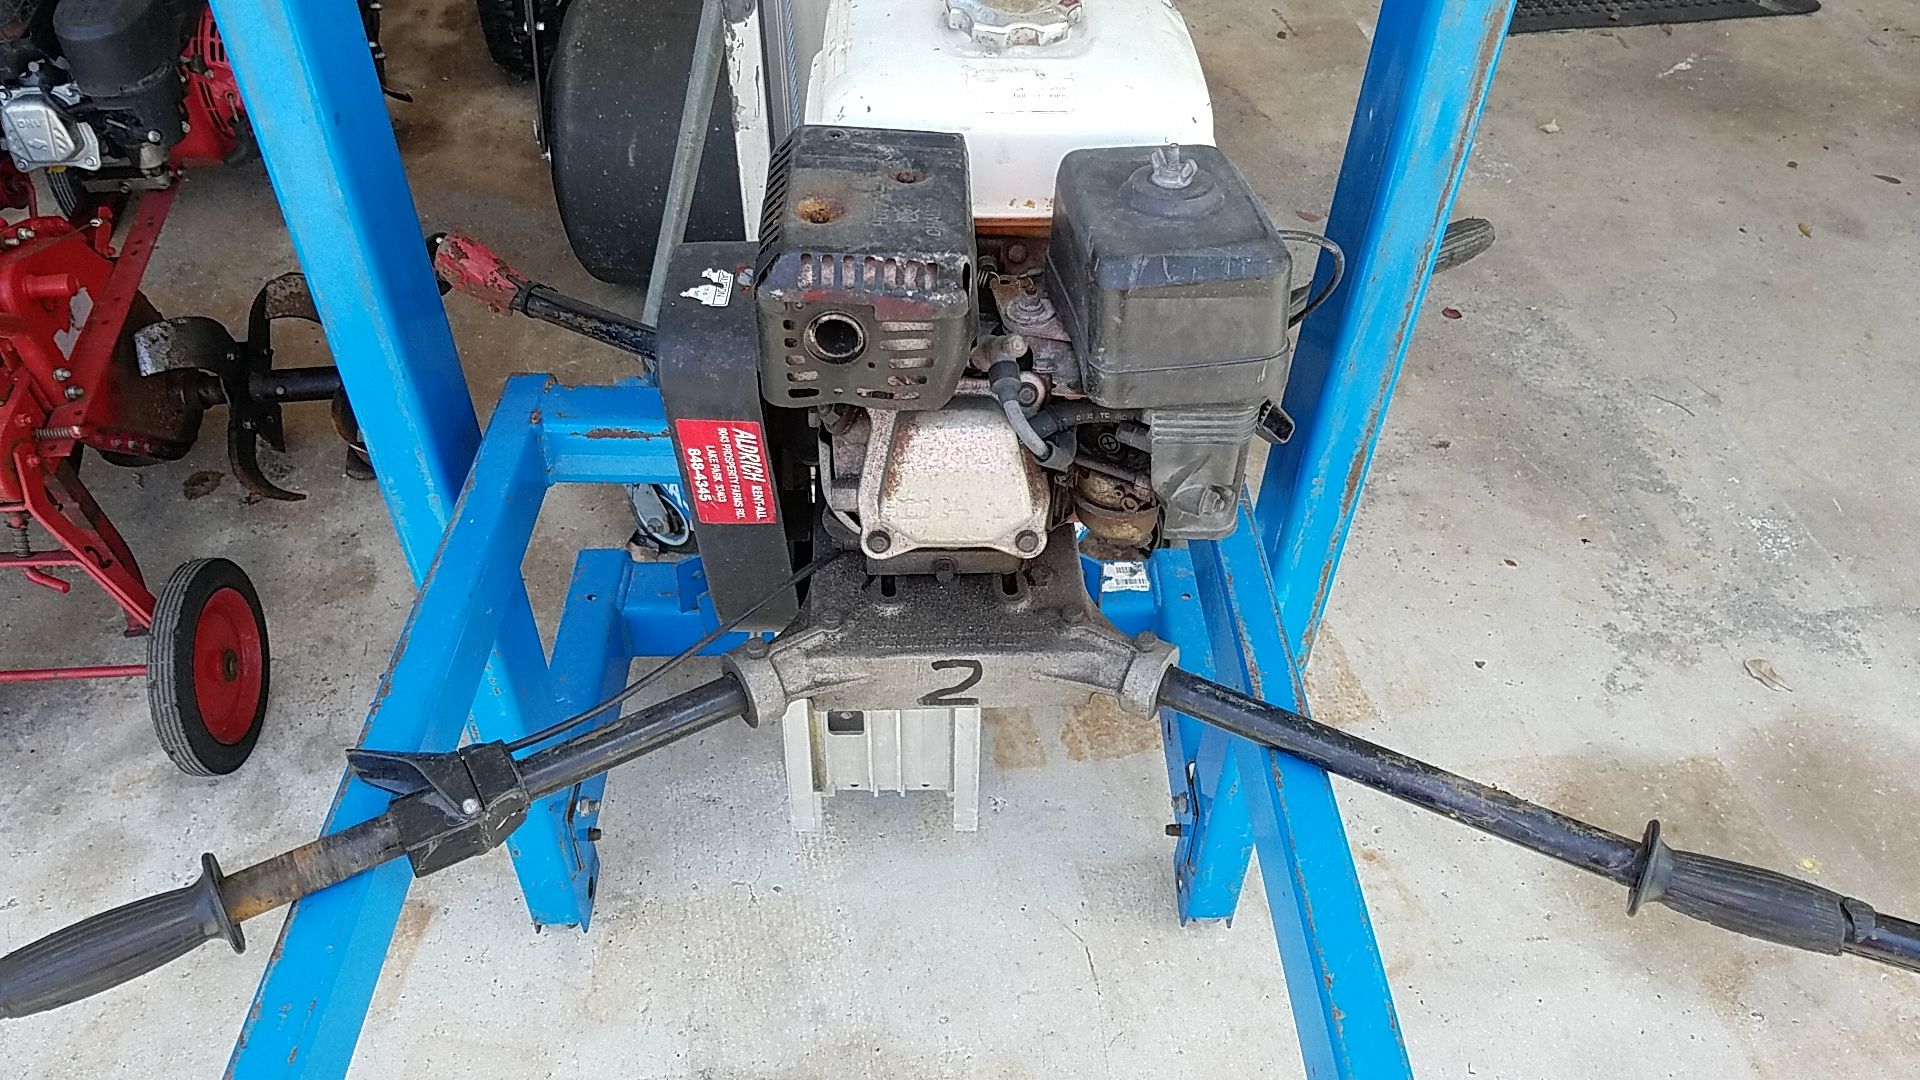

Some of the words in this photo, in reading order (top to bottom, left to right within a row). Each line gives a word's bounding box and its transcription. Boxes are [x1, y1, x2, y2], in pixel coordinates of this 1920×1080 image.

[717, 427, 730, 443] 9043
[705, 445, 719, 463] LAKE
[721, 444, 739, 484] PROSPERITY
[687, 448, 712, 502] 848-4345
[710, 464, 723, 482] PARK
[732, 427, 766, 483] ALDRICH
[751, 485, 767, 520] RENT-ALL
[714, 484, 728, 503] 33403
[731, 484, 745, 508] FARMS
[917, 659, 983, 706] 2
